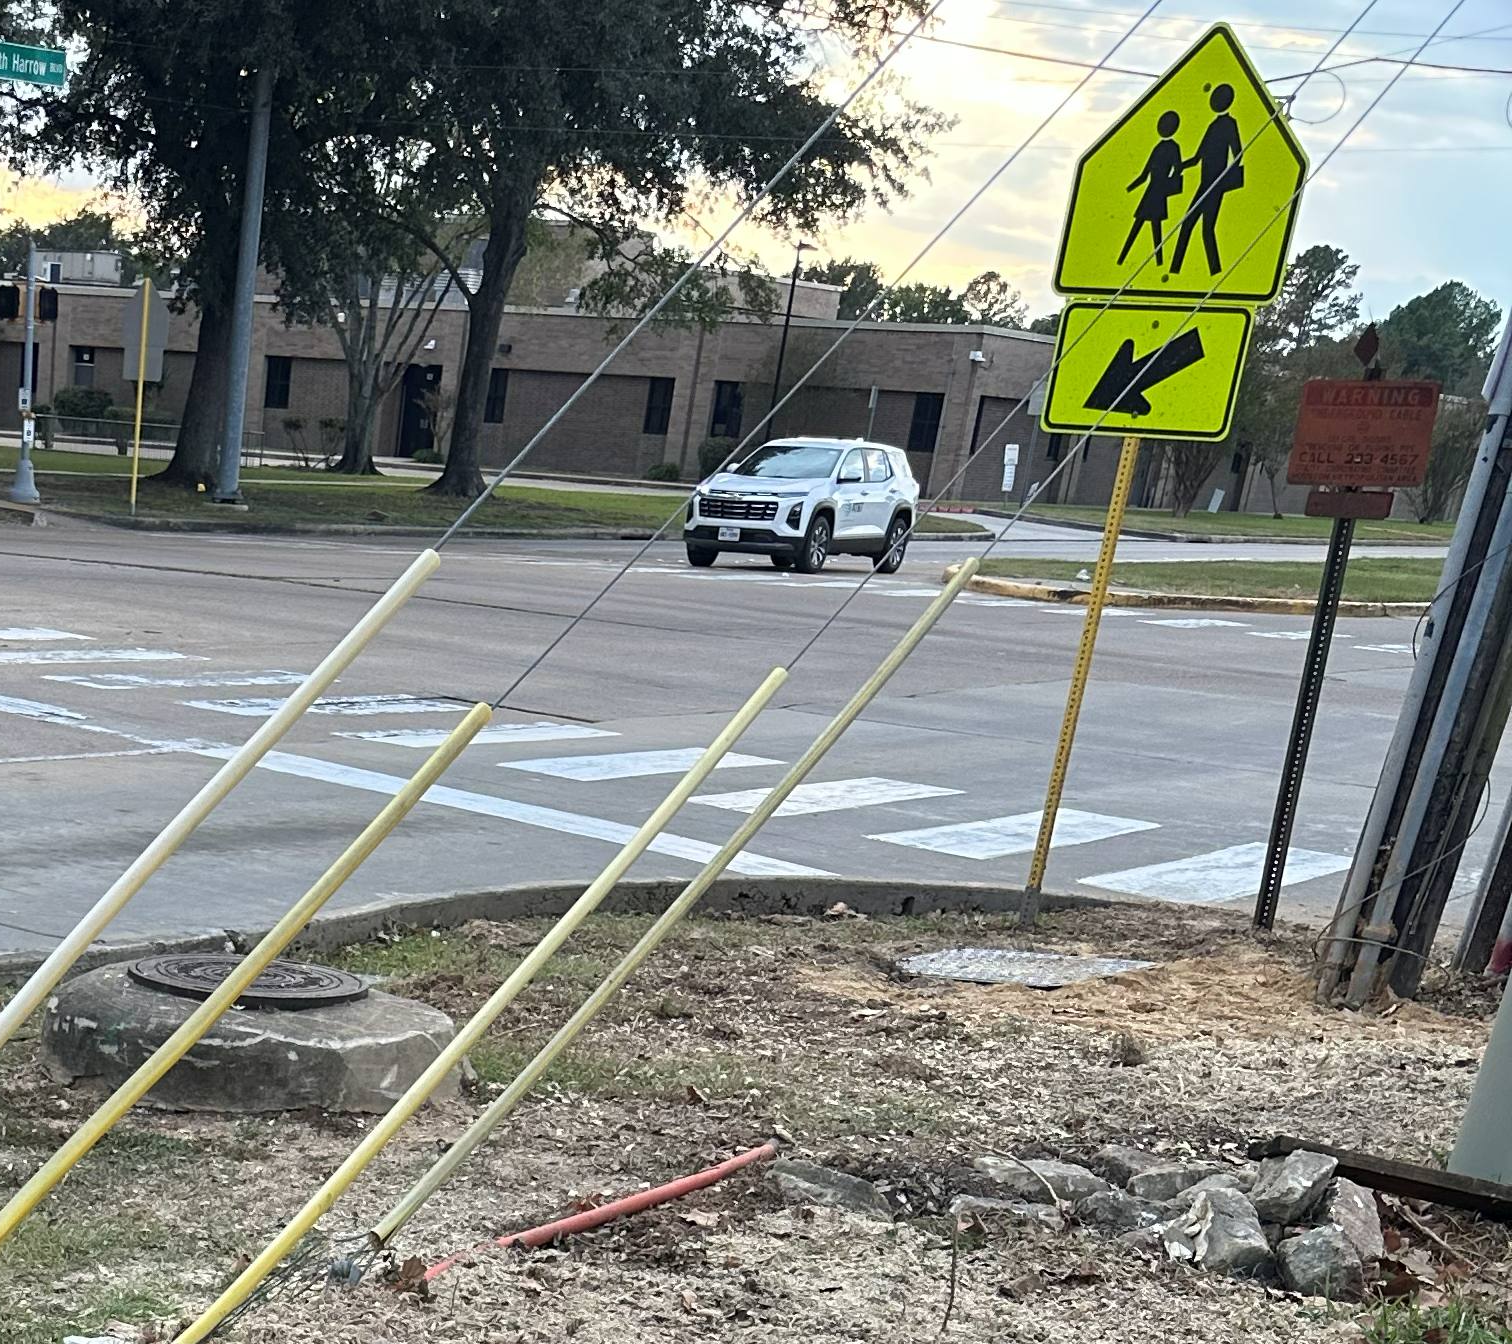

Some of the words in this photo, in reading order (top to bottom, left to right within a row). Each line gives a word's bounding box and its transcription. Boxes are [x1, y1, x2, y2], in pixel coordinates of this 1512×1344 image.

[12, 53, 47, 76] Harrow
[1322, 388, 1421, 405] WARNING
[1298, 451, 1335, 464] CALL
